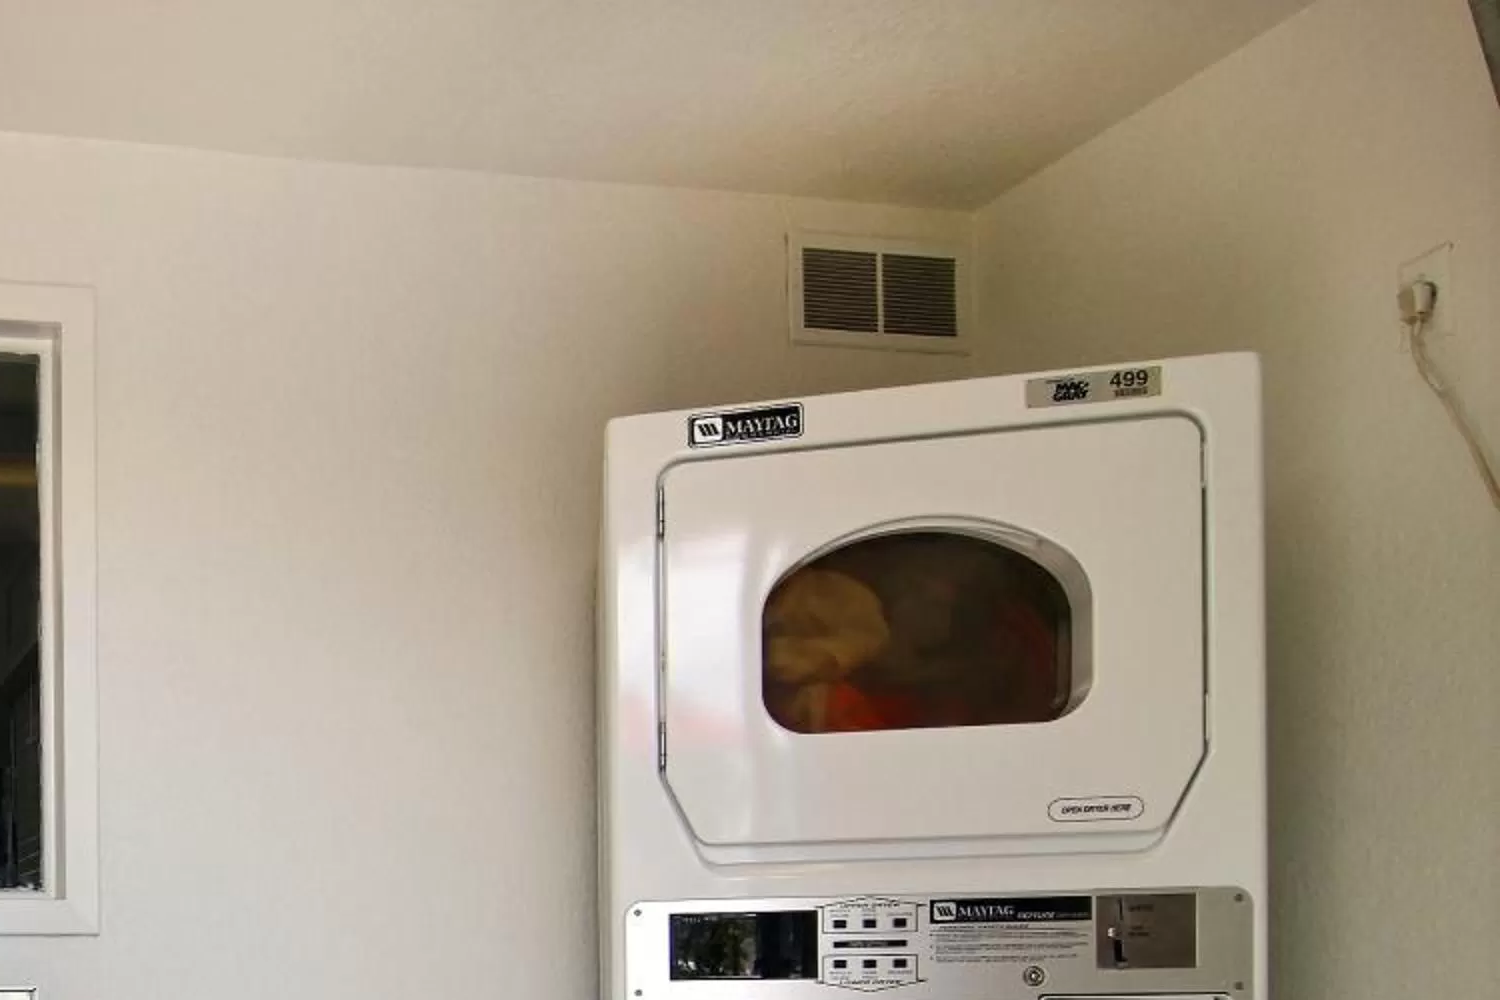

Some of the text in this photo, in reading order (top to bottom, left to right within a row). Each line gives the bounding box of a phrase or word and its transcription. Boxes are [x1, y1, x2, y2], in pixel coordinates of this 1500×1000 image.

[1109, 369, 1148, 387] 499
[726, 413, 798, 434] MAYTAG
[958, 905, 1015, 917] MAYTAG
